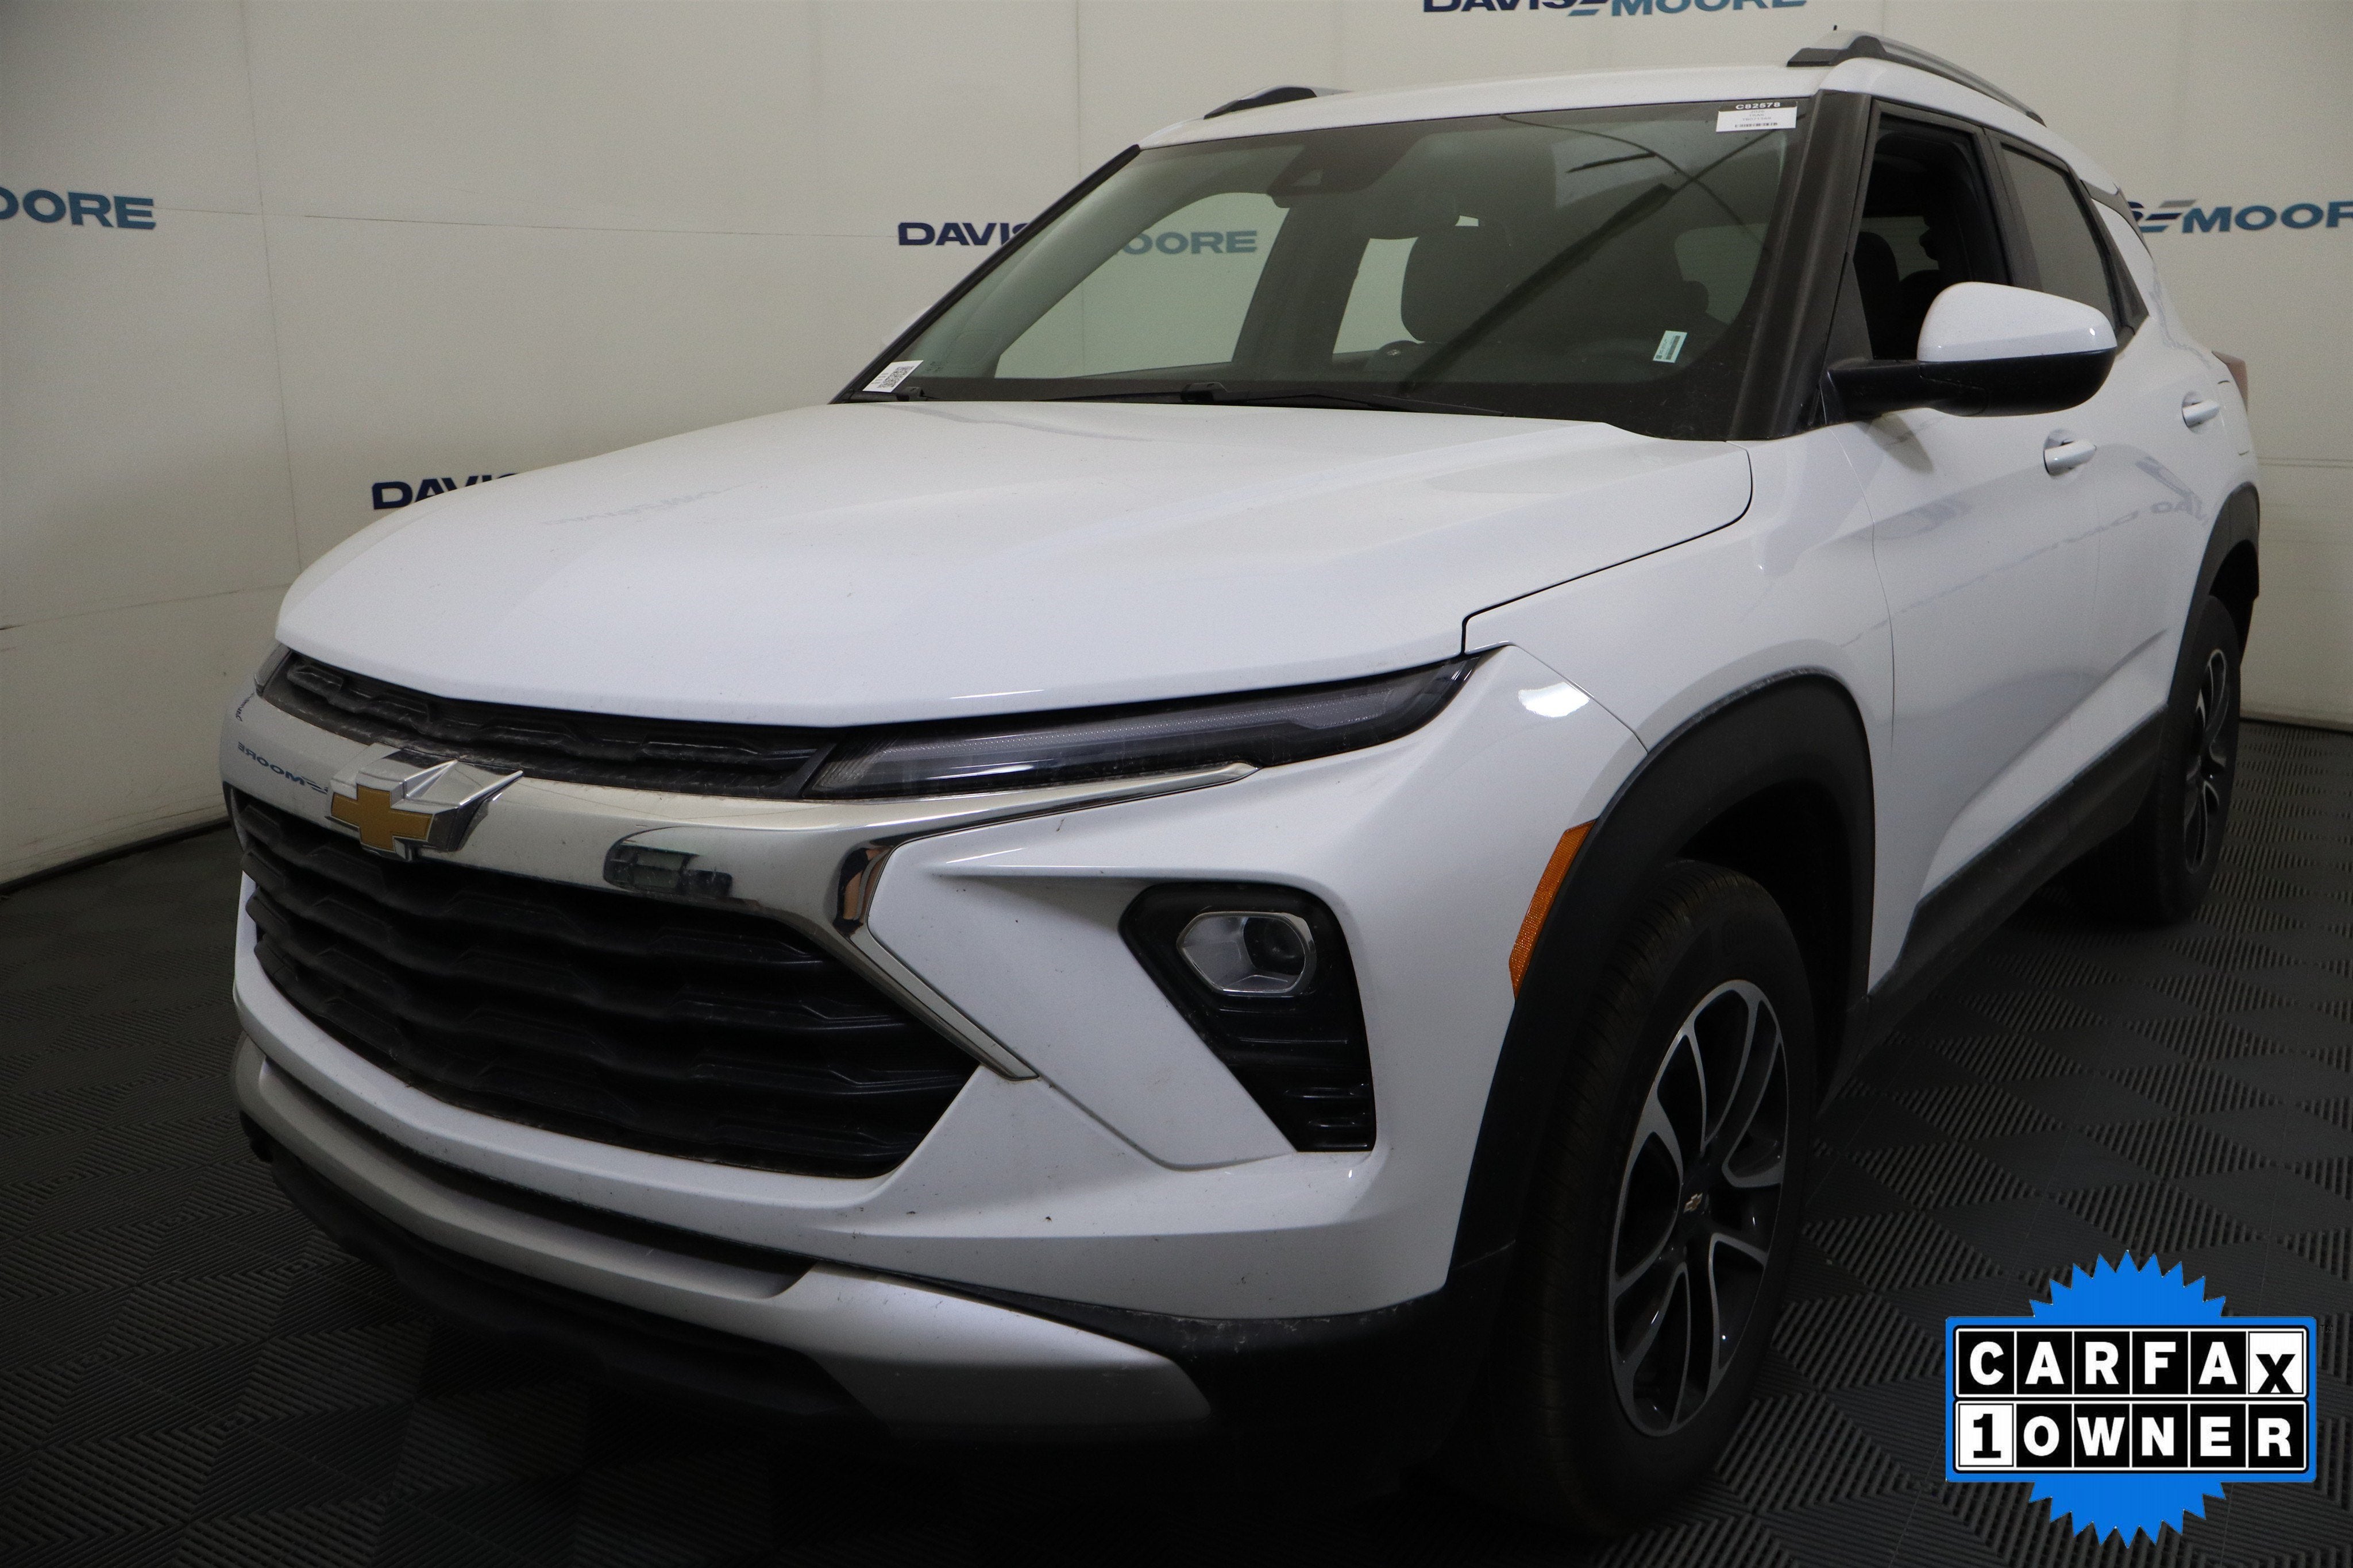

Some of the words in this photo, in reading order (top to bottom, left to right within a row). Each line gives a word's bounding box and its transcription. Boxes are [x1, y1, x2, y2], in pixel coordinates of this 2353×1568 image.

[898, 222, 1029, 245] DAVI
[1119, 230, 1257, 254] OORE
[372, 473, 518, 509] DAV
